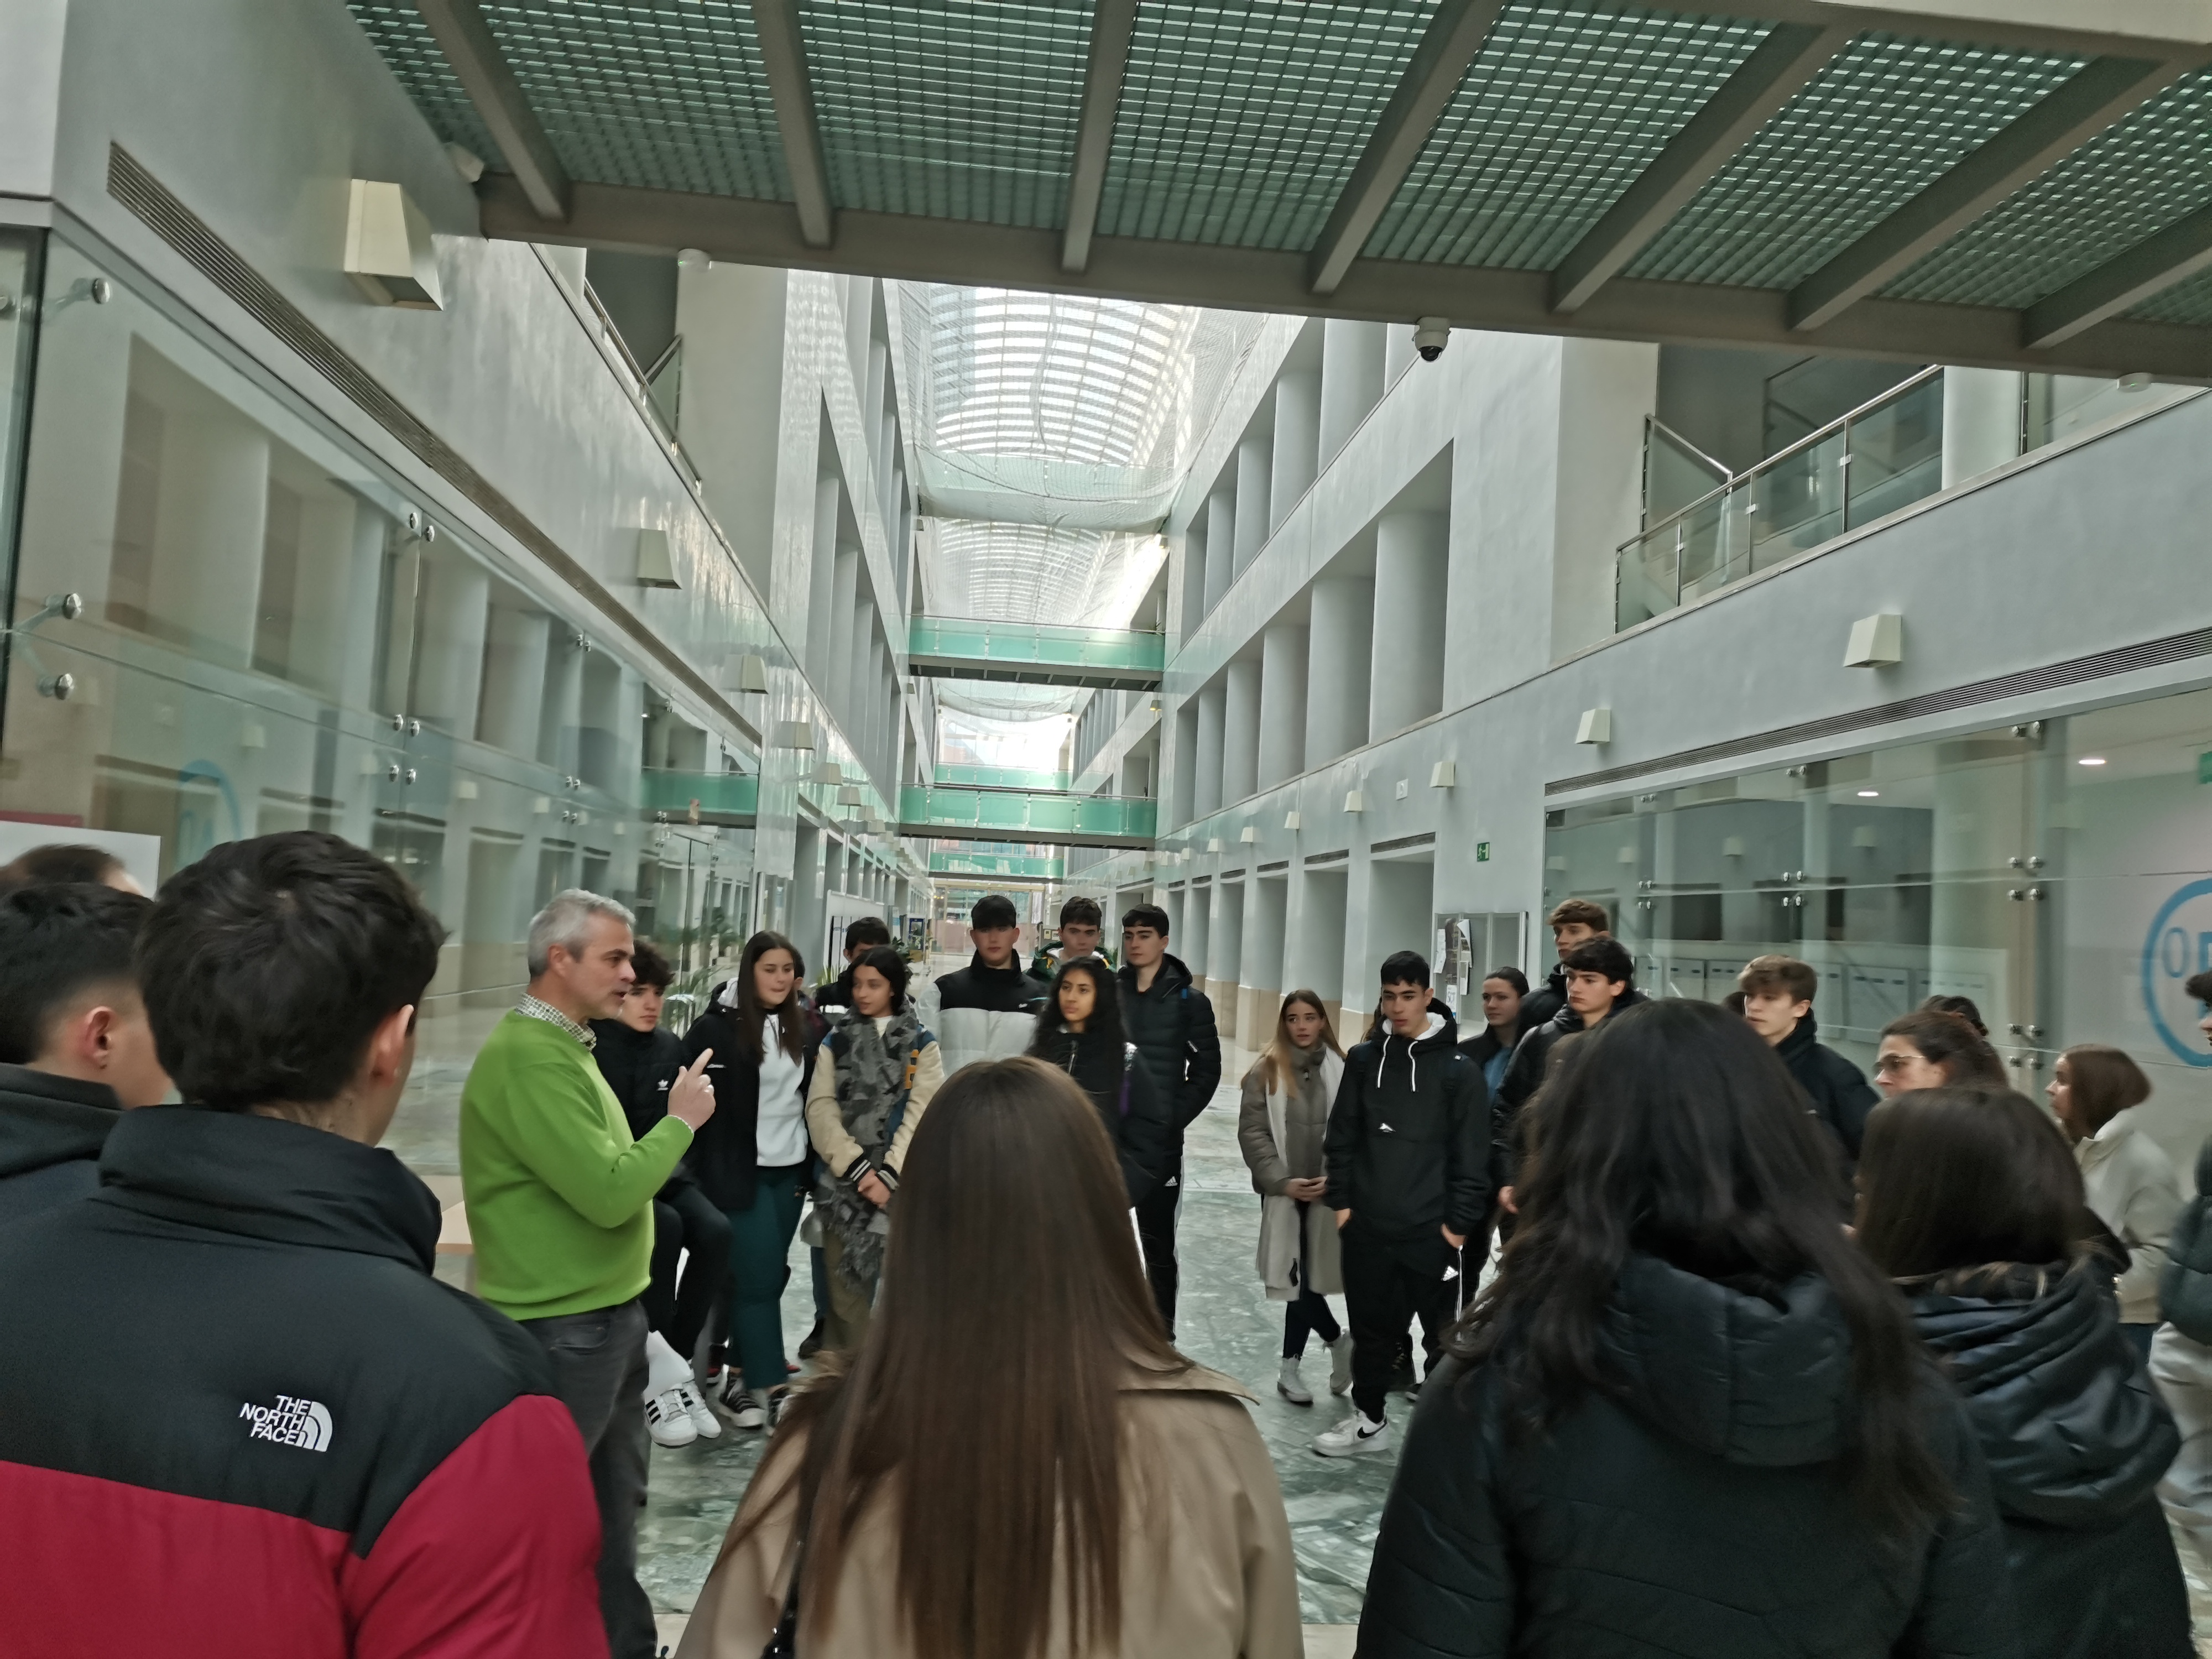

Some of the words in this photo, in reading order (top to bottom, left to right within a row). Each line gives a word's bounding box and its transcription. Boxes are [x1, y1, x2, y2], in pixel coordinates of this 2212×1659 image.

[276, 1395, 311, 1415] THE
[239, 1402, 305, 1431] NORTH
[250, 1422, 299, 1444] FACE
